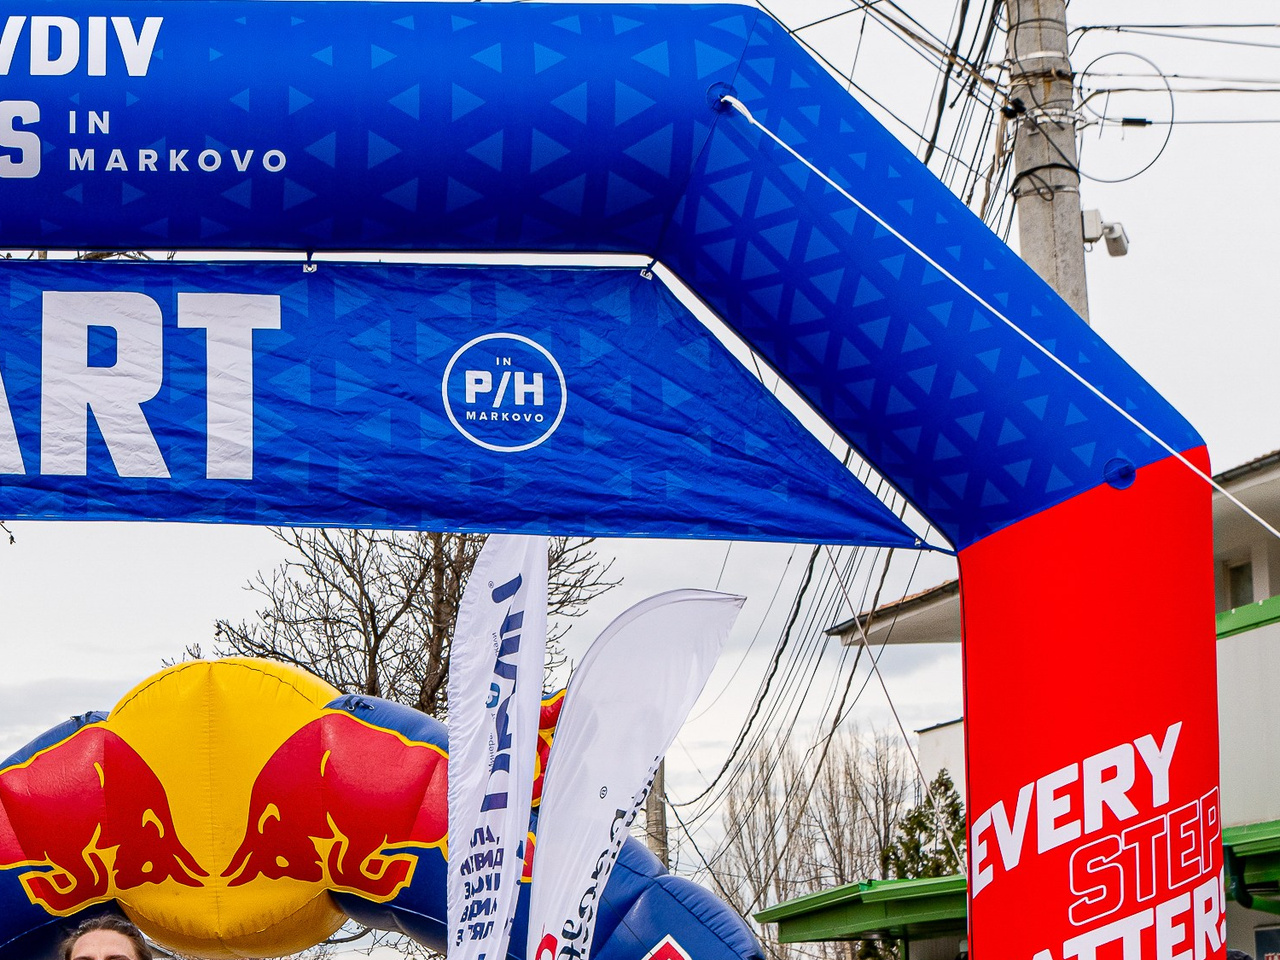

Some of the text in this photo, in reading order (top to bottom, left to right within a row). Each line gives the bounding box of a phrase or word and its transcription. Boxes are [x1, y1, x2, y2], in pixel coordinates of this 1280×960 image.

[69, 111, 111, 134] IN
[69, 149, 288, 172] MARKOVO
[495, 357, 512, 366] IN
[465, 370, 544, 408] P/H
[466, 411, 544, 423] MARKOVO
[971, 721, 1183, 899] EVERY
[1068, 786, 1221, 926] STEP
